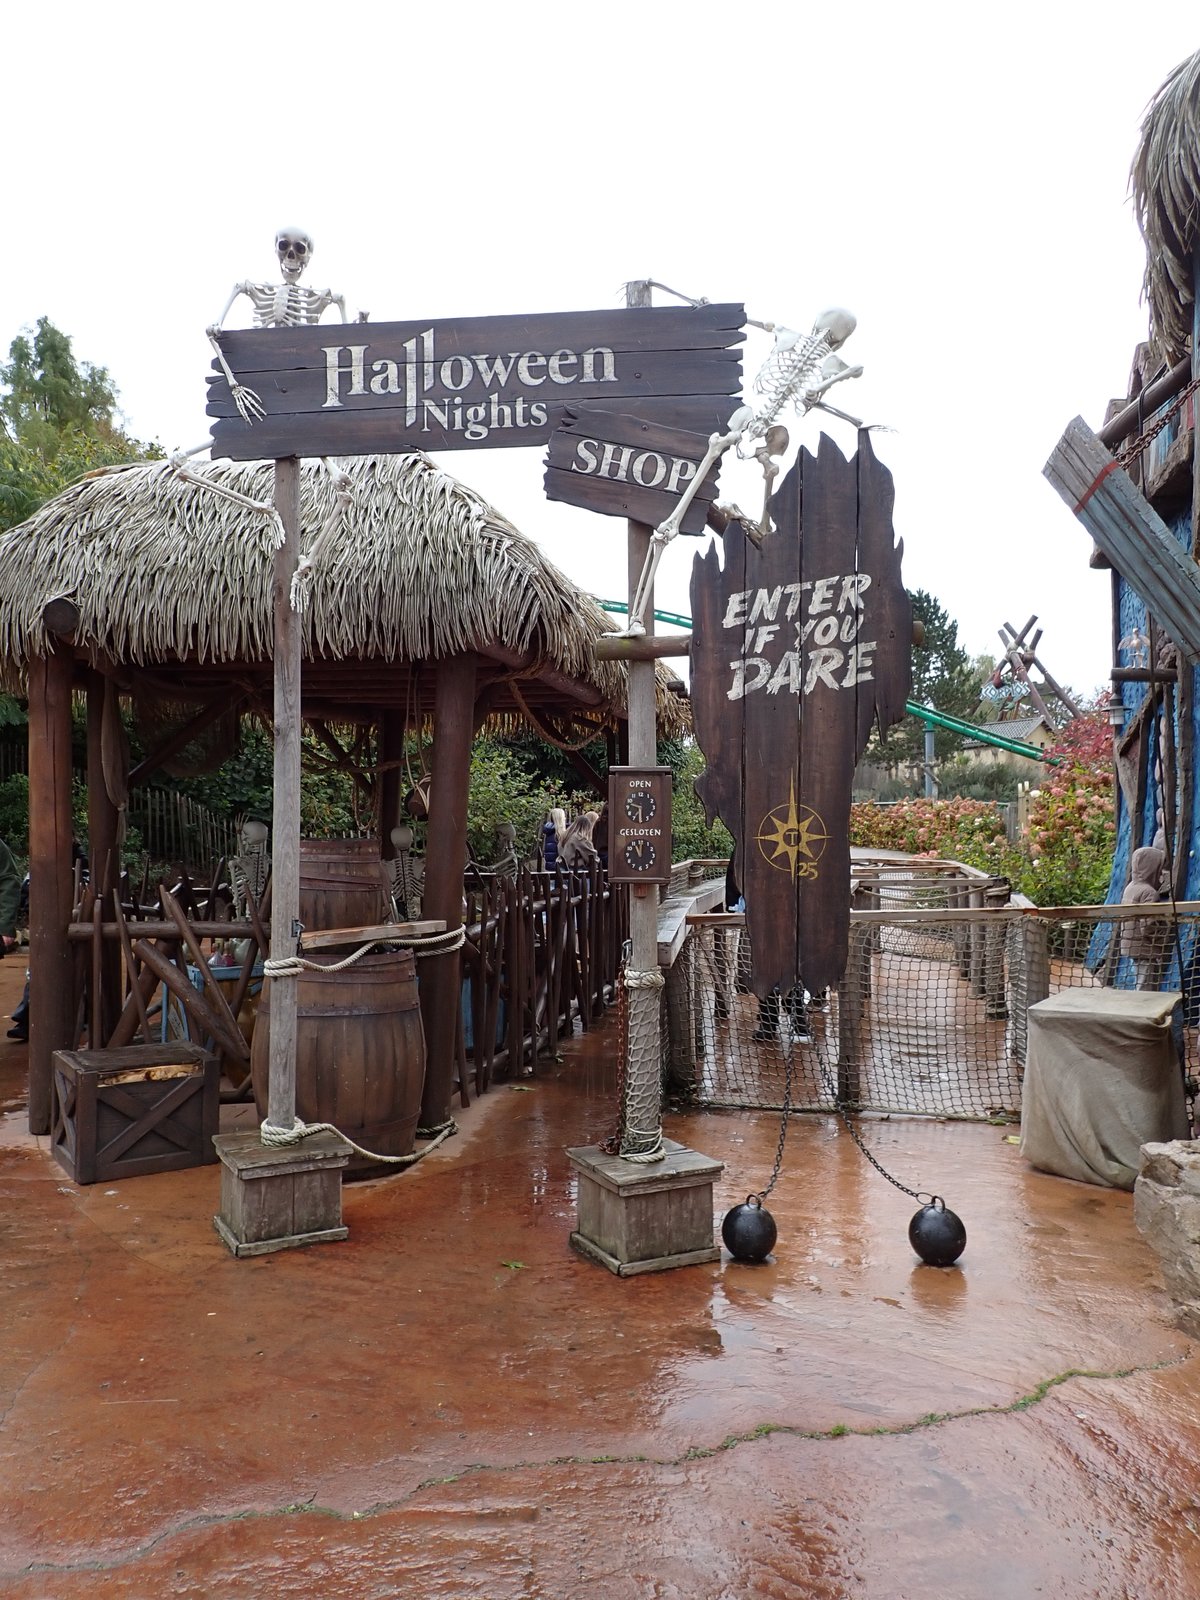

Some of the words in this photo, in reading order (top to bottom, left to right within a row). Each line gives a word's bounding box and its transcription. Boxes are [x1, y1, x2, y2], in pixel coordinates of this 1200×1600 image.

[320, 327, 619, 428] Halloween
[420, 392, 548, 440] Nights
[571, 439, 698, 493] SHOP
[721, 573, 872, 629] ENTER
[740, 623, 780, 654] IF
[793, 613, 864, 652] YOU
[726, 641, 878, 701] DARE
[629, 780, 652, 788] OPEN
[619, 828, 661, 836] GESLOTEN
[785, 831, 799, 846] T
[798, 862, 819, 880] 25
